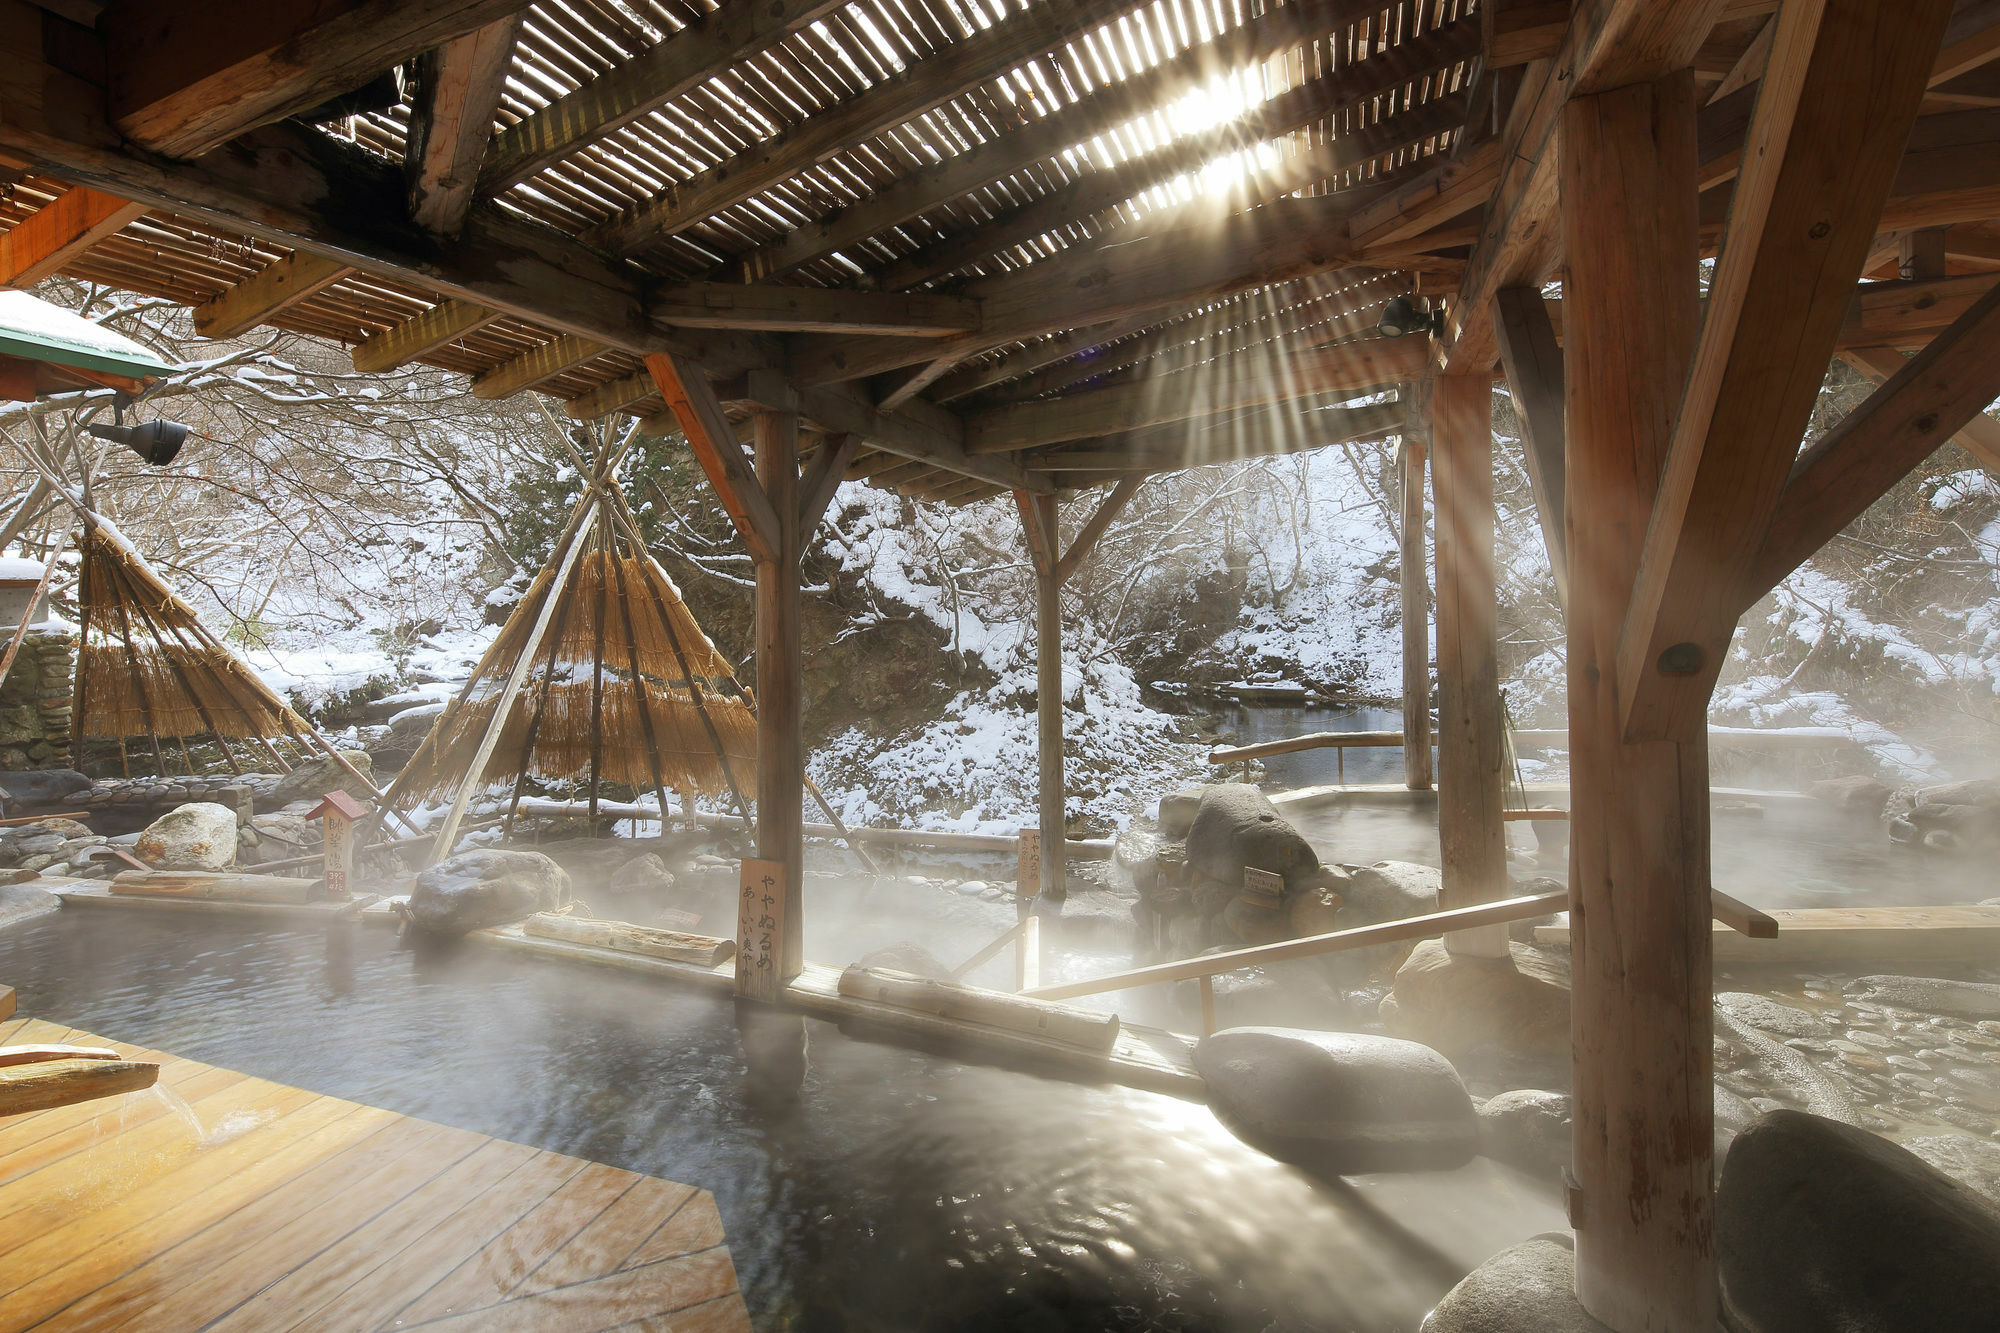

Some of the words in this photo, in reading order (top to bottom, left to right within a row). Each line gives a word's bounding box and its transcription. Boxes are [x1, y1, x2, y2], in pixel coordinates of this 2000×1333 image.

[756, 875, 776, 972] ややぬるめ
